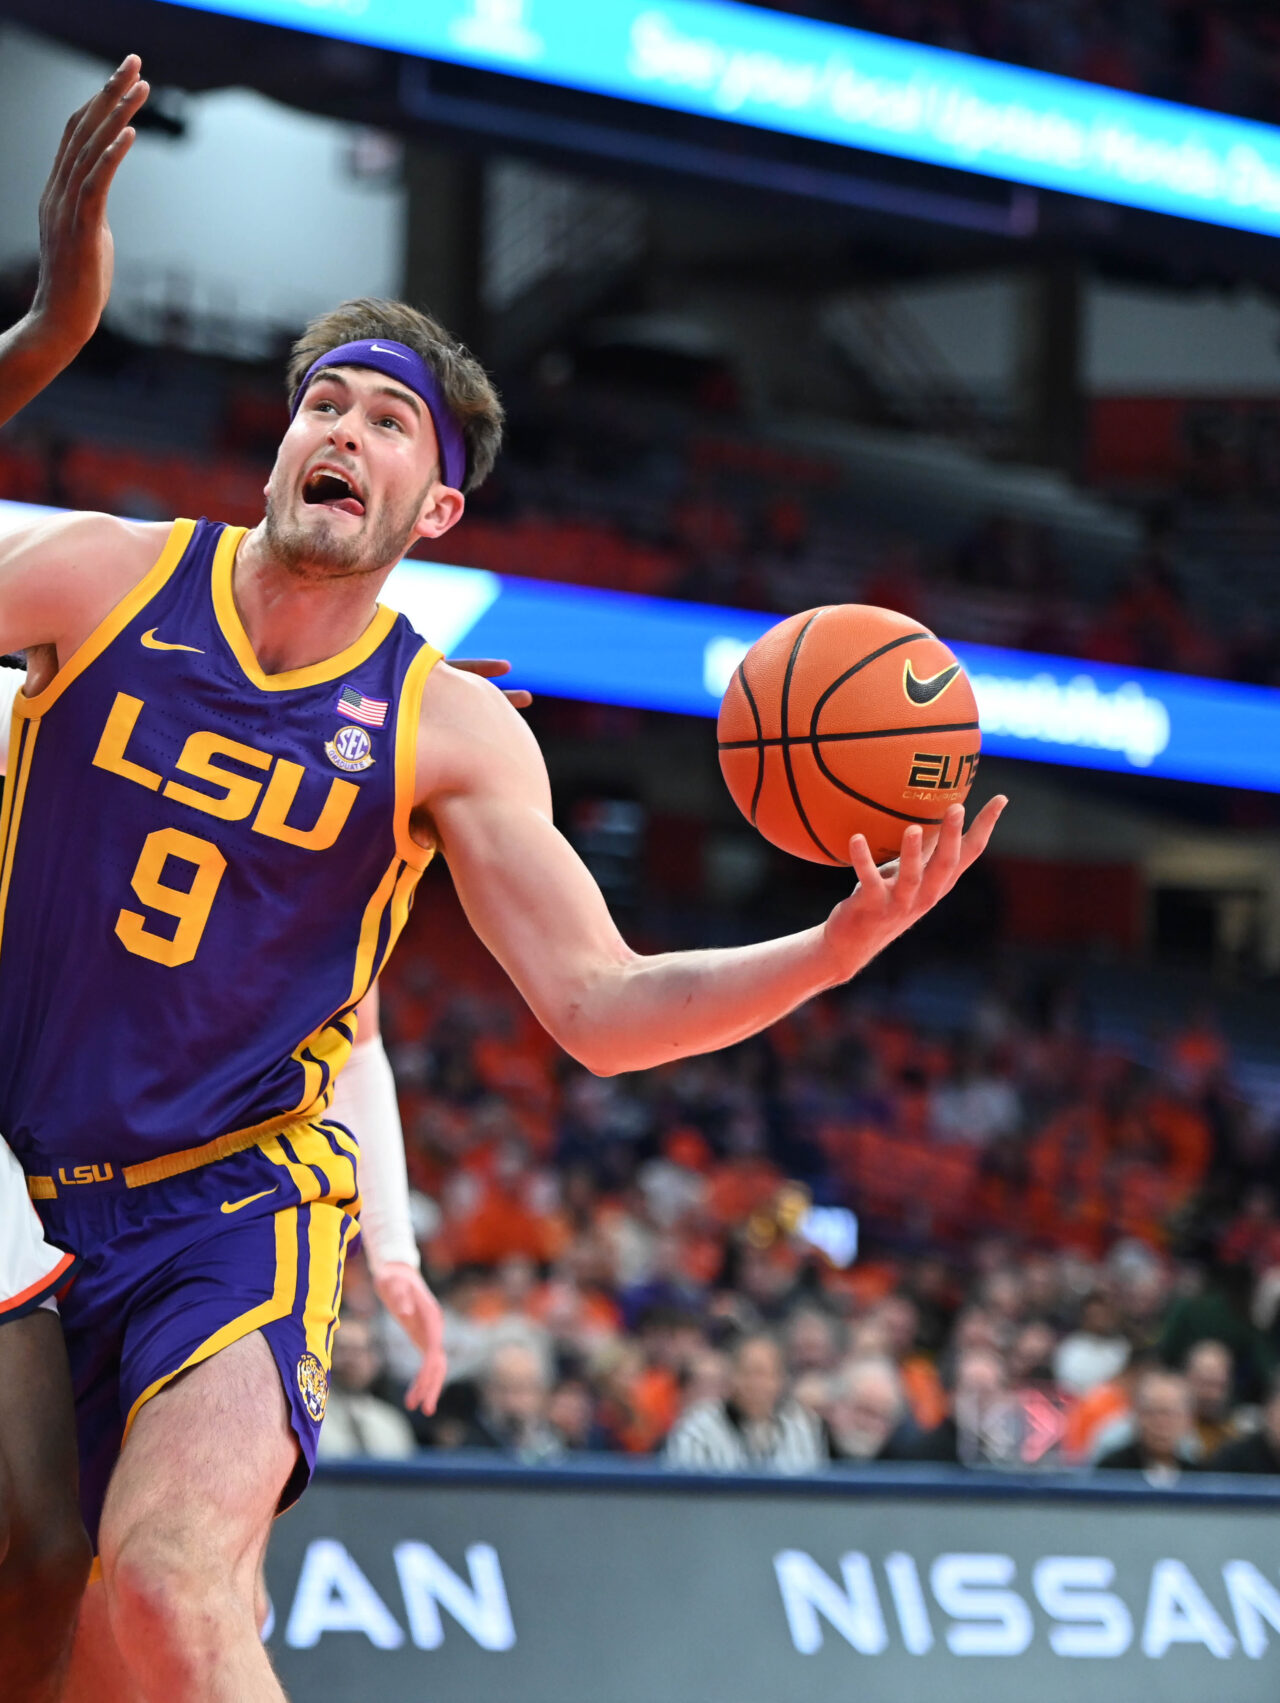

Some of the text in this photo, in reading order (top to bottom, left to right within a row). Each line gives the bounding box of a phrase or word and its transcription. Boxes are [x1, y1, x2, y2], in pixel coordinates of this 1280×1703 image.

[628, 11, 722, 90] See
[717, 51, 819, 112] your
[821, 52, 928, 134] local
[92, 691, 360, 851] LSU
[328, 749, 366, 770] GRADUATE
[336, 728, 369, 760] SEC
[115, 827, 228, 968] 9
[58, 1162, 114, 1185] LSU
